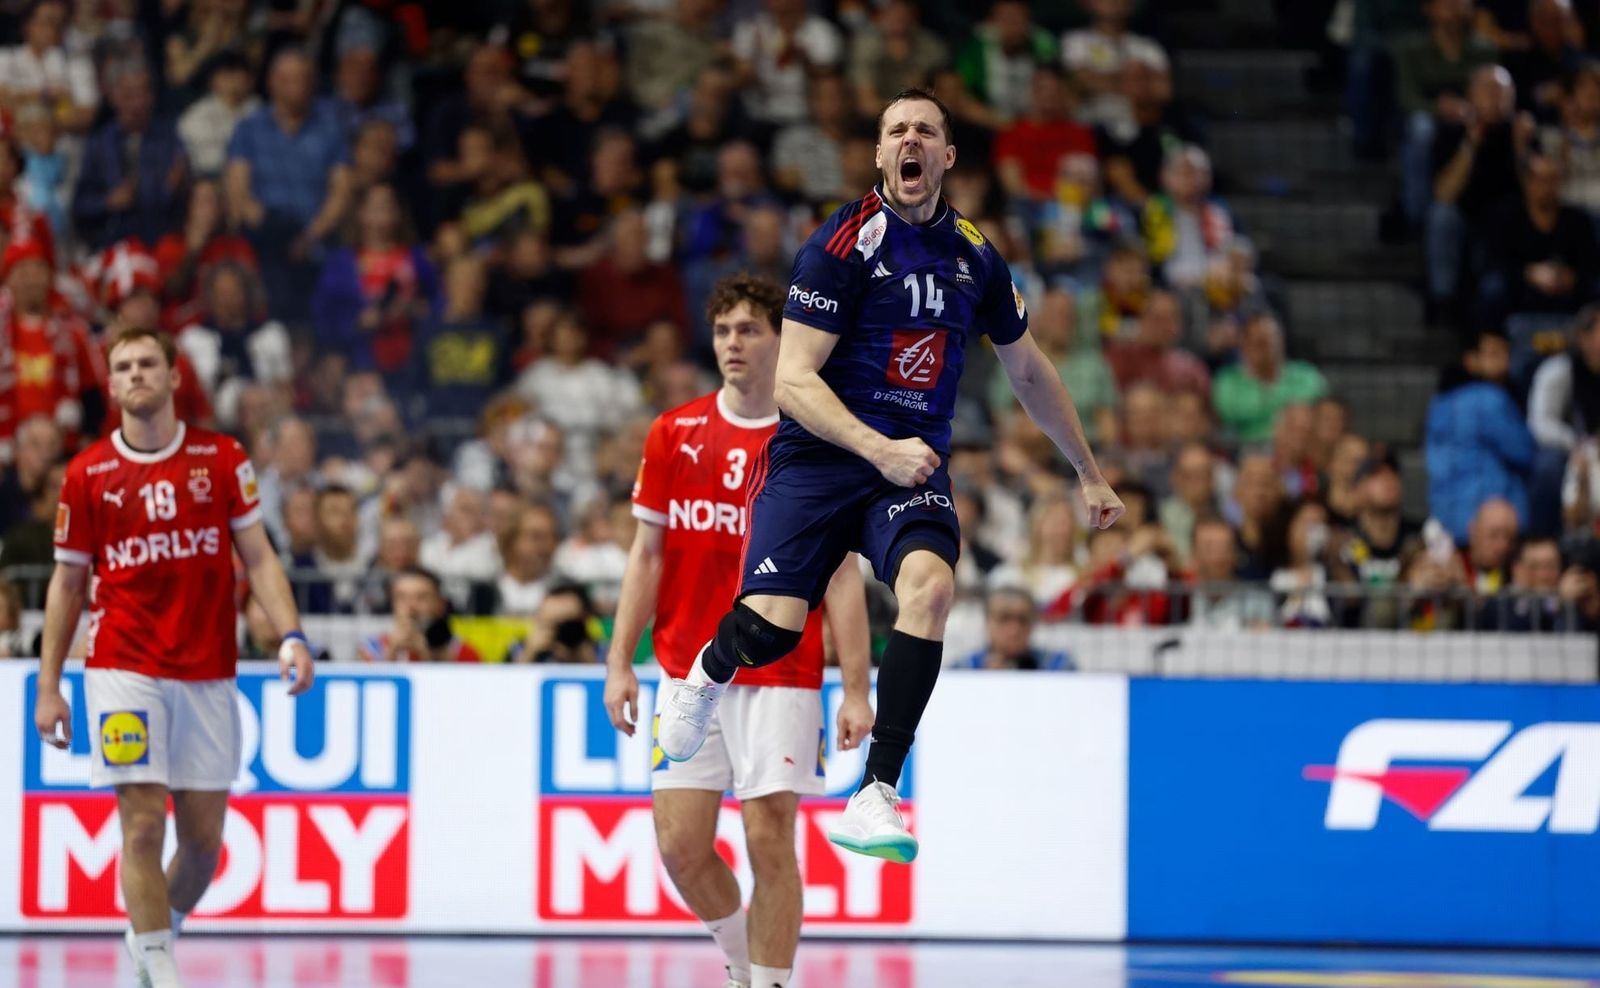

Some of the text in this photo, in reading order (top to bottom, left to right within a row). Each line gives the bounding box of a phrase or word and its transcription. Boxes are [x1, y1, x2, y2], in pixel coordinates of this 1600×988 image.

[903, 273, 945, 318] 14
[722, 448, 748, 490] 3
[138, 480, 177, 522] 19
[105, 526, 220, 571] NORLYS
